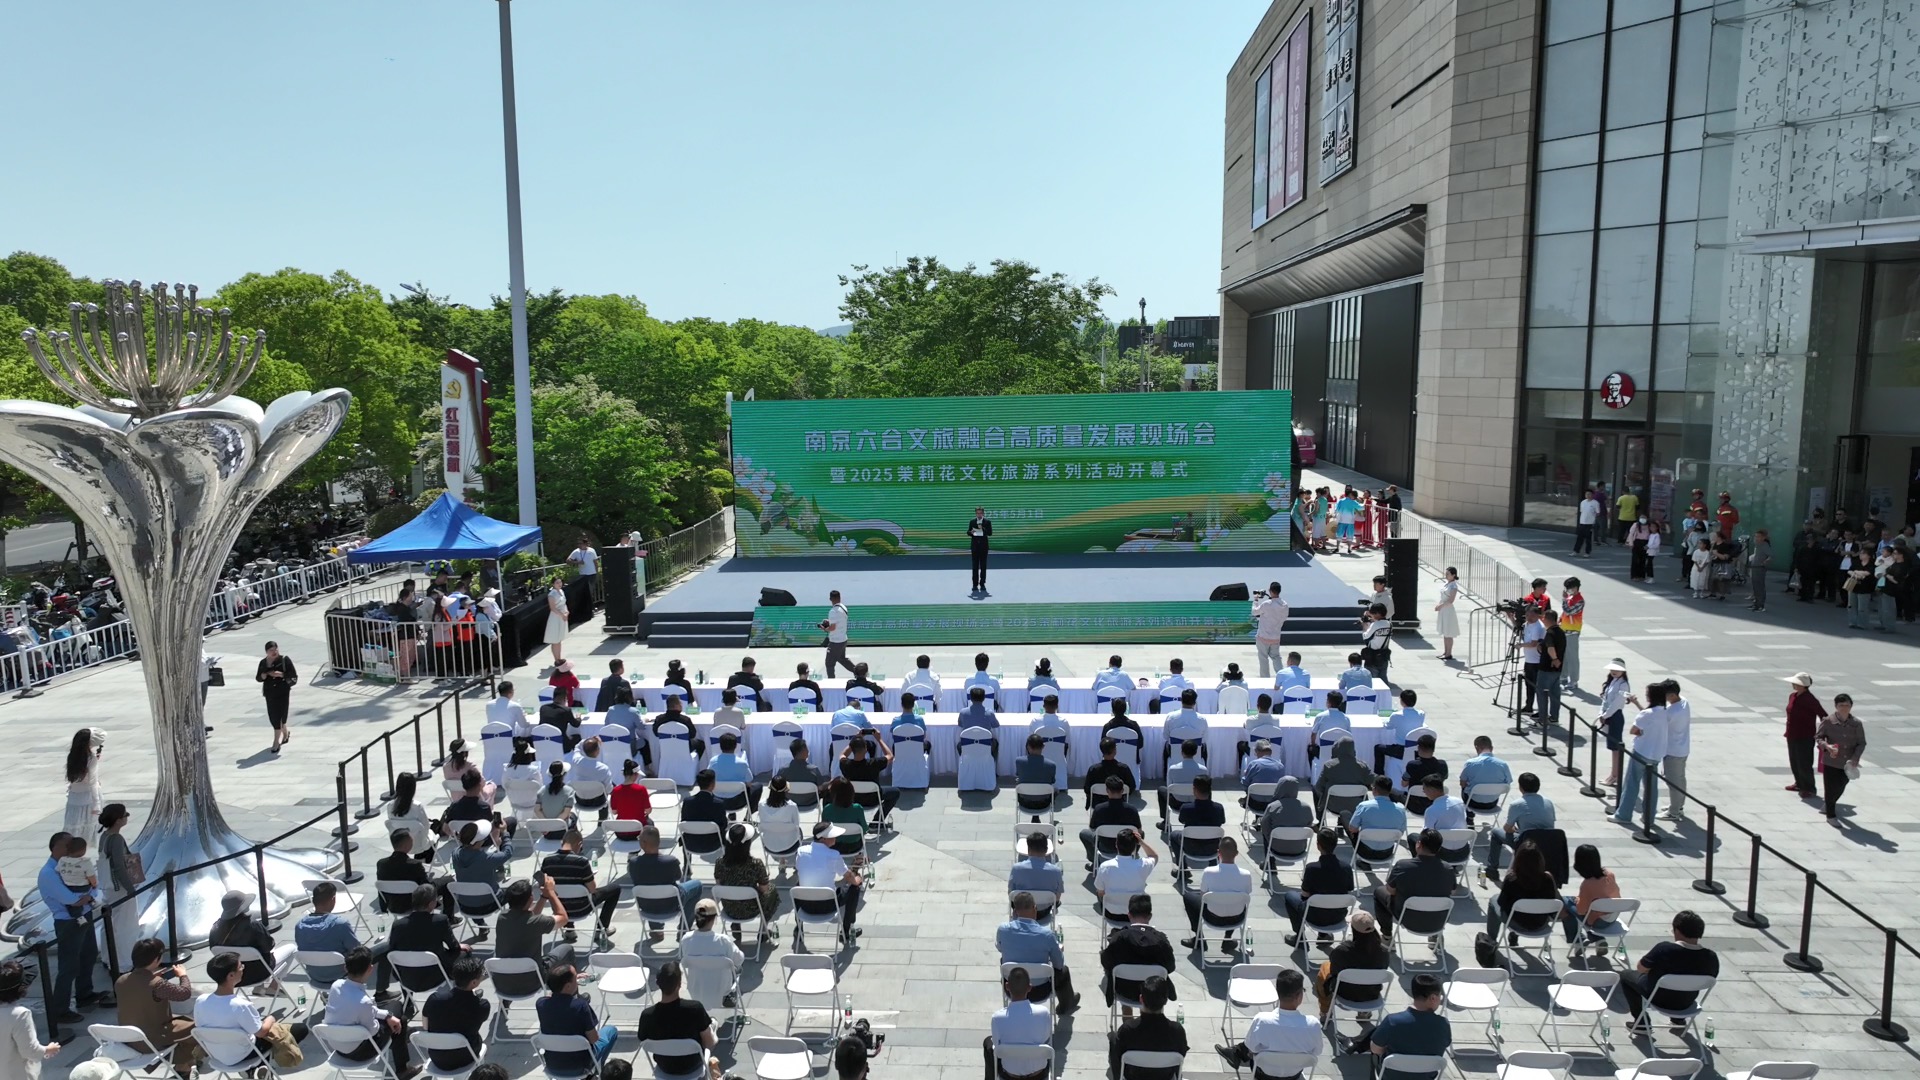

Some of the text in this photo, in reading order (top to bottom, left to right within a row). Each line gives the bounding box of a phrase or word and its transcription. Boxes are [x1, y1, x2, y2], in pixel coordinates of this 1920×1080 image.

[804, 421, 1217, 452] 南京六合文旅融合高质量发展现场会
[830, 460, 1189, 484] 暨2025茉莉花文化旅游系列活动开幕式
